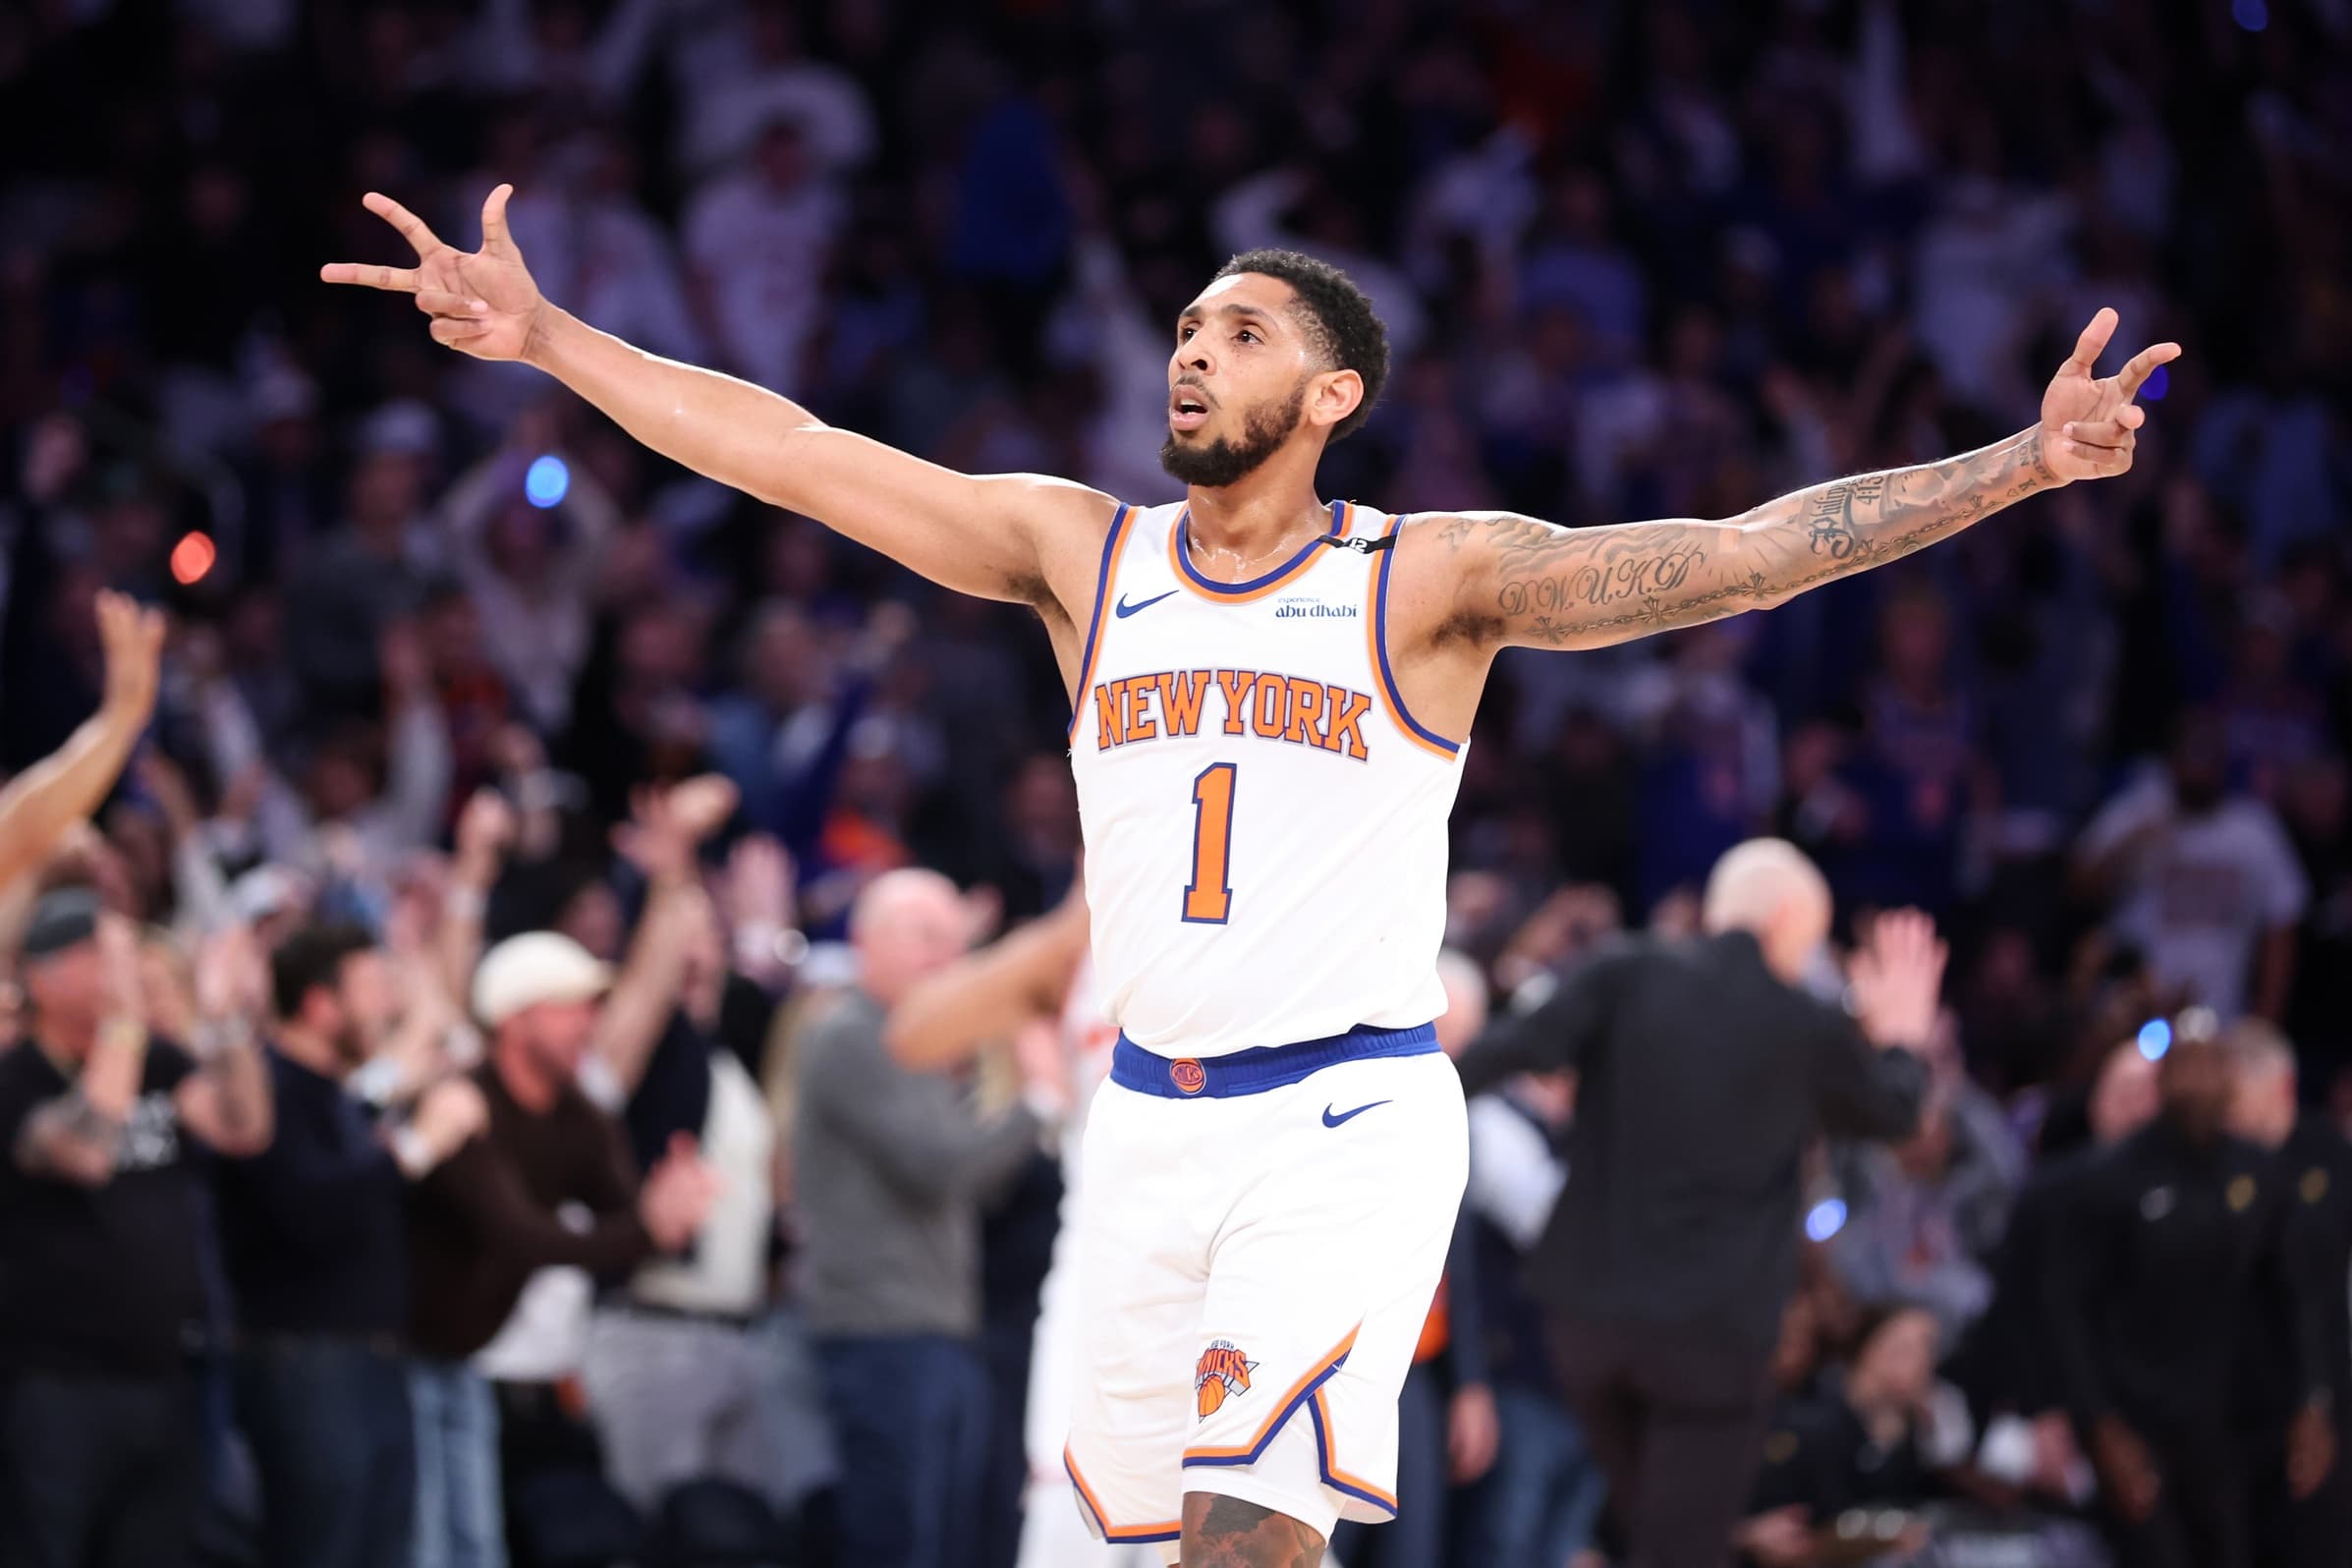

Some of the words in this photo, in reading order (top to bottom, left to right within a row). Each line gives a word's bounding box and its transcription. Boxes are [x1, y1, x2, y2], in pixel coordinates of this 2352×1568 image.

[1349, 537, 1368, 553] 12
[1275, 605, 1307, 617] abu
[1310, 604, 1358, 617] dhabi
[1093, 669, 1212, 752] NEW
[1215, 668, 1372, 763] YORK
[1181, 762, 1238, 925] 1
